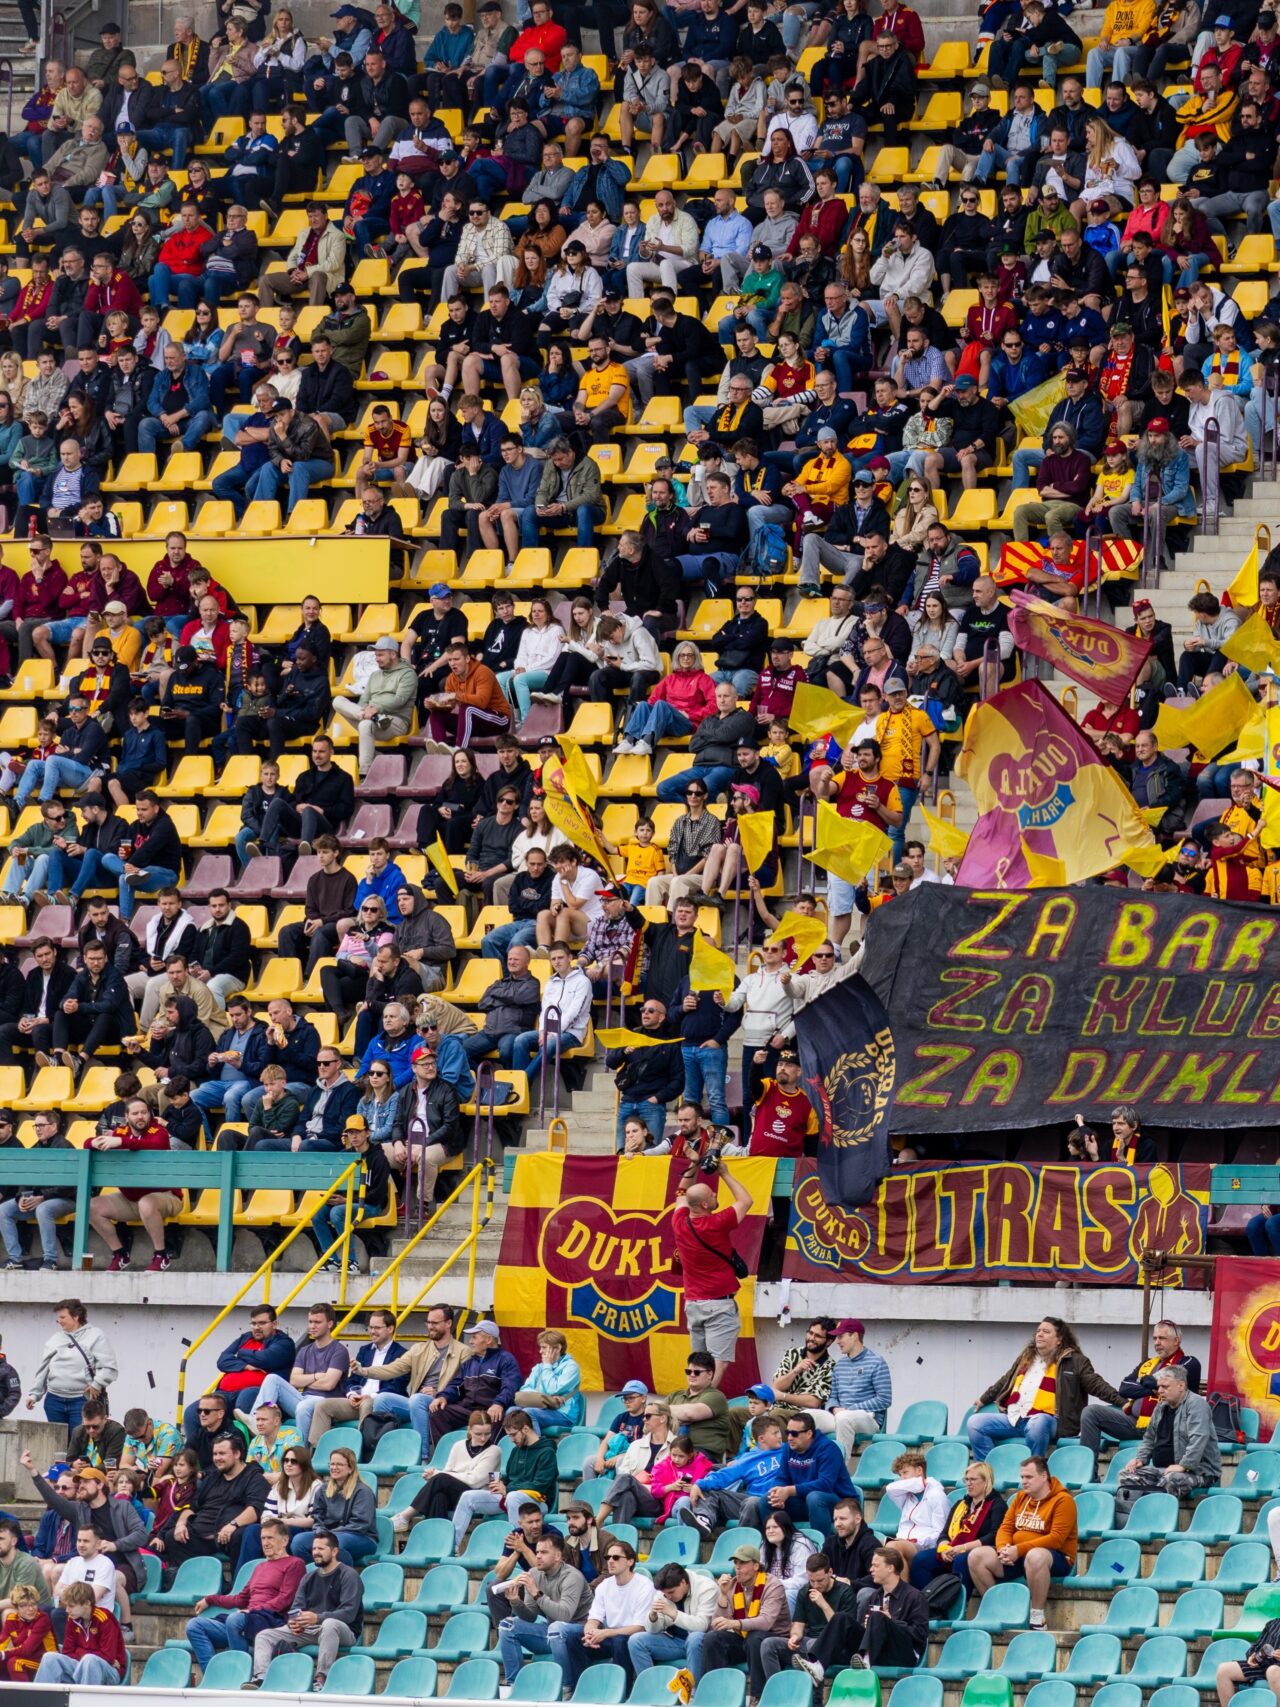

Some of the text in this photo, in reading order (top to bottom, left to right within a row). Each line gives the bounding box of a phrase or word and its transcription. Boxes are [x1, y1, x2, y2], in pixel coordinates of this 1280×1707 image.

[172, 683, 203, 695] Steelers
[948, 889, 1078, 961] ZA
[927, 967, 1055, 1034] ZA
[894, 1044, 1023, 1107] ZA
[556, 1219, 673, 1276] DUKL
[804, 1233, 833, 1261] PRAHA
[807, 1188, 861, 1249] DUKLA
[859, 1162, 1136, 1275] ULTRAS
[591, 1300, 659, 1332] PRAHA
